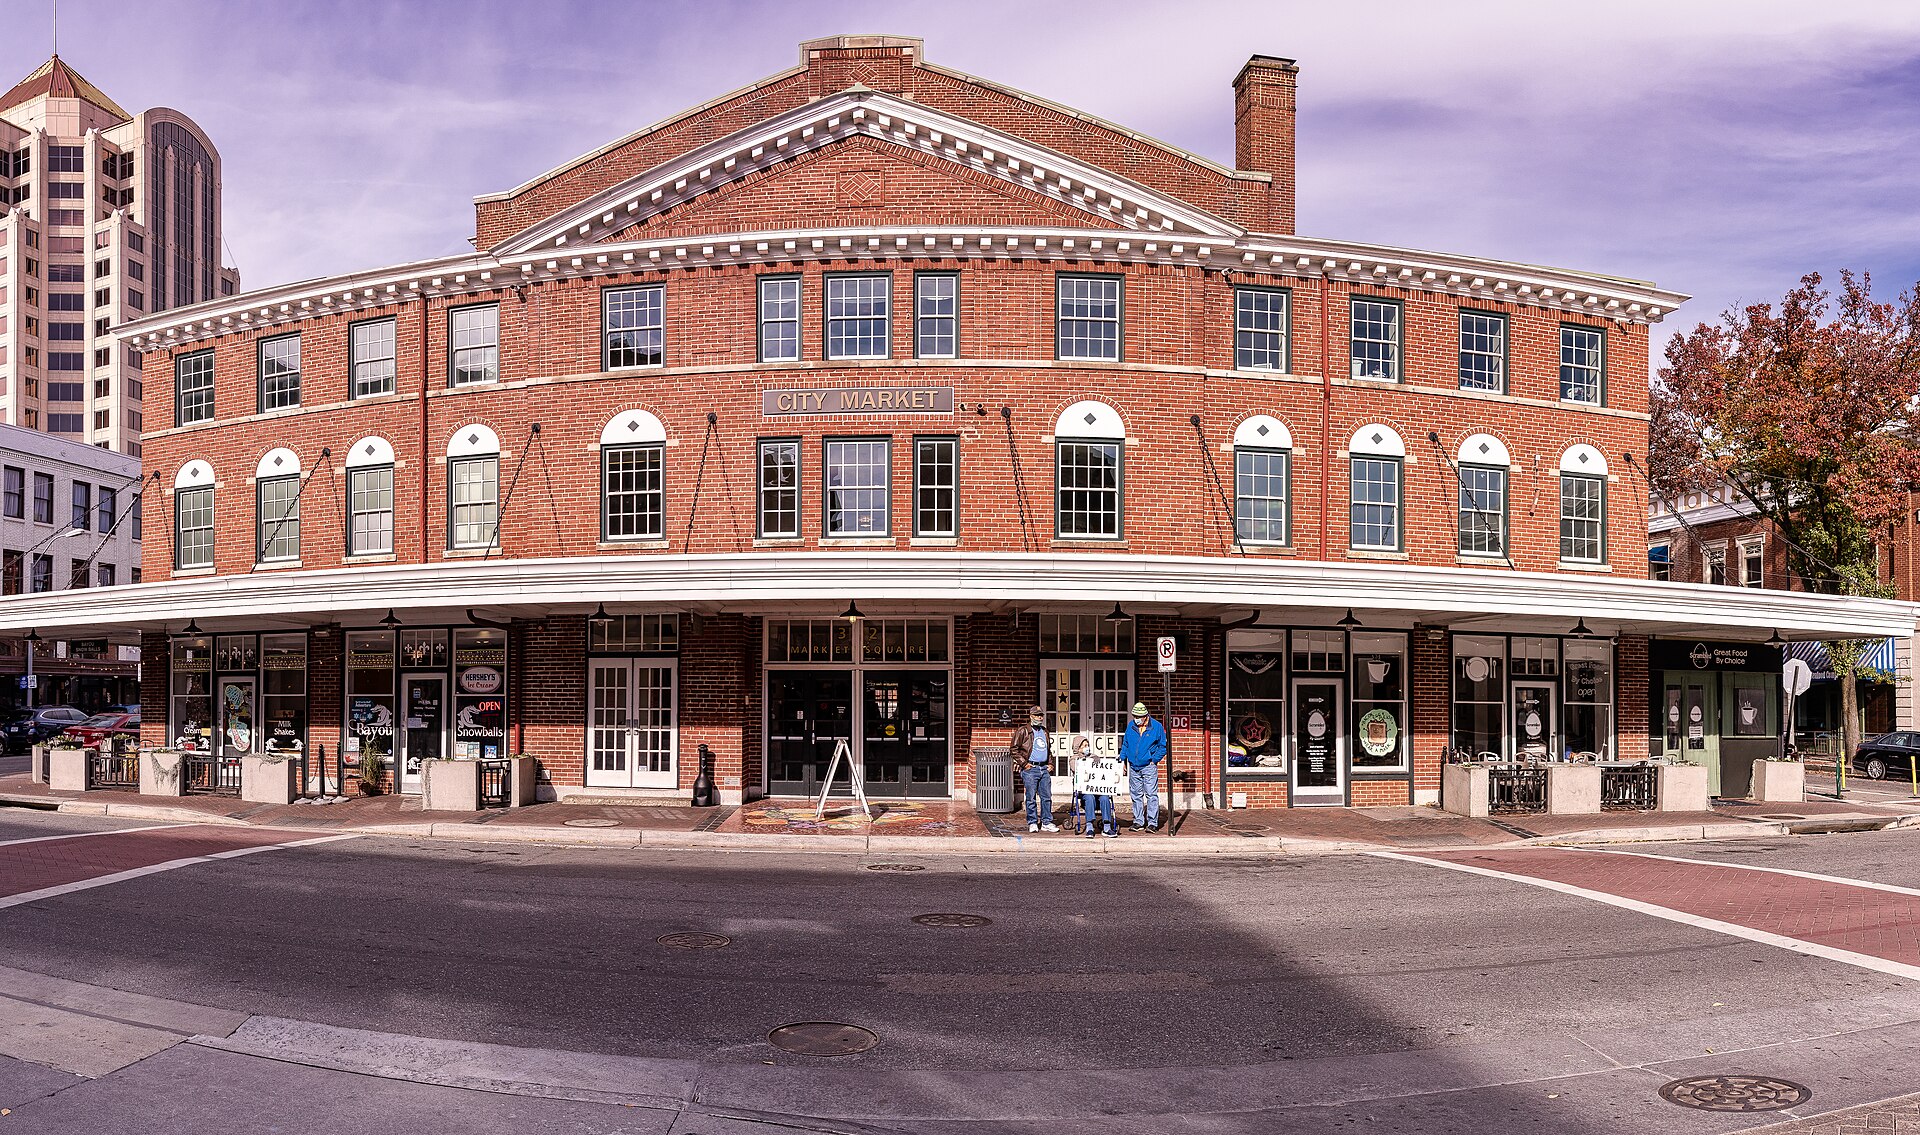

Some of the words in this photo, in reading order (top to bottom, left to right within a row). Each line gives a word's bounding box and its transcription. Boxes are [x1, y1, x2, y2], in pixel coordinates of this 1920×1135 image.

[777, 392, 827, 411] CITY
[840, 390, 938, 409] MARKET
[790, 645, 849, 654] MARKET
[865, 645, 924, 655] SQUARE
[1713, 648, 1731, 657] Great
[1731, 649, 1748, 657] Food
[1724, 657, 1746, 665] Choice
[465, 673, 496, 681] HERSHEY'S
[1812, 671, 1826, 679] eafood
[1577, 688, 1597, 698] open
[478, 701, 501, 711] OPEN
[278, 720, 292, 728] Milk
[184, 727, 202, 735] Cream
[274, 728, 296, 736] Shakes
[351, 720, 393, 743] Bayou
[457, 726, 504, 737] Snowballs
[1091, 761, 1113, 770] PEACE
[1086, 785, 1117, 794] PRACTICE
